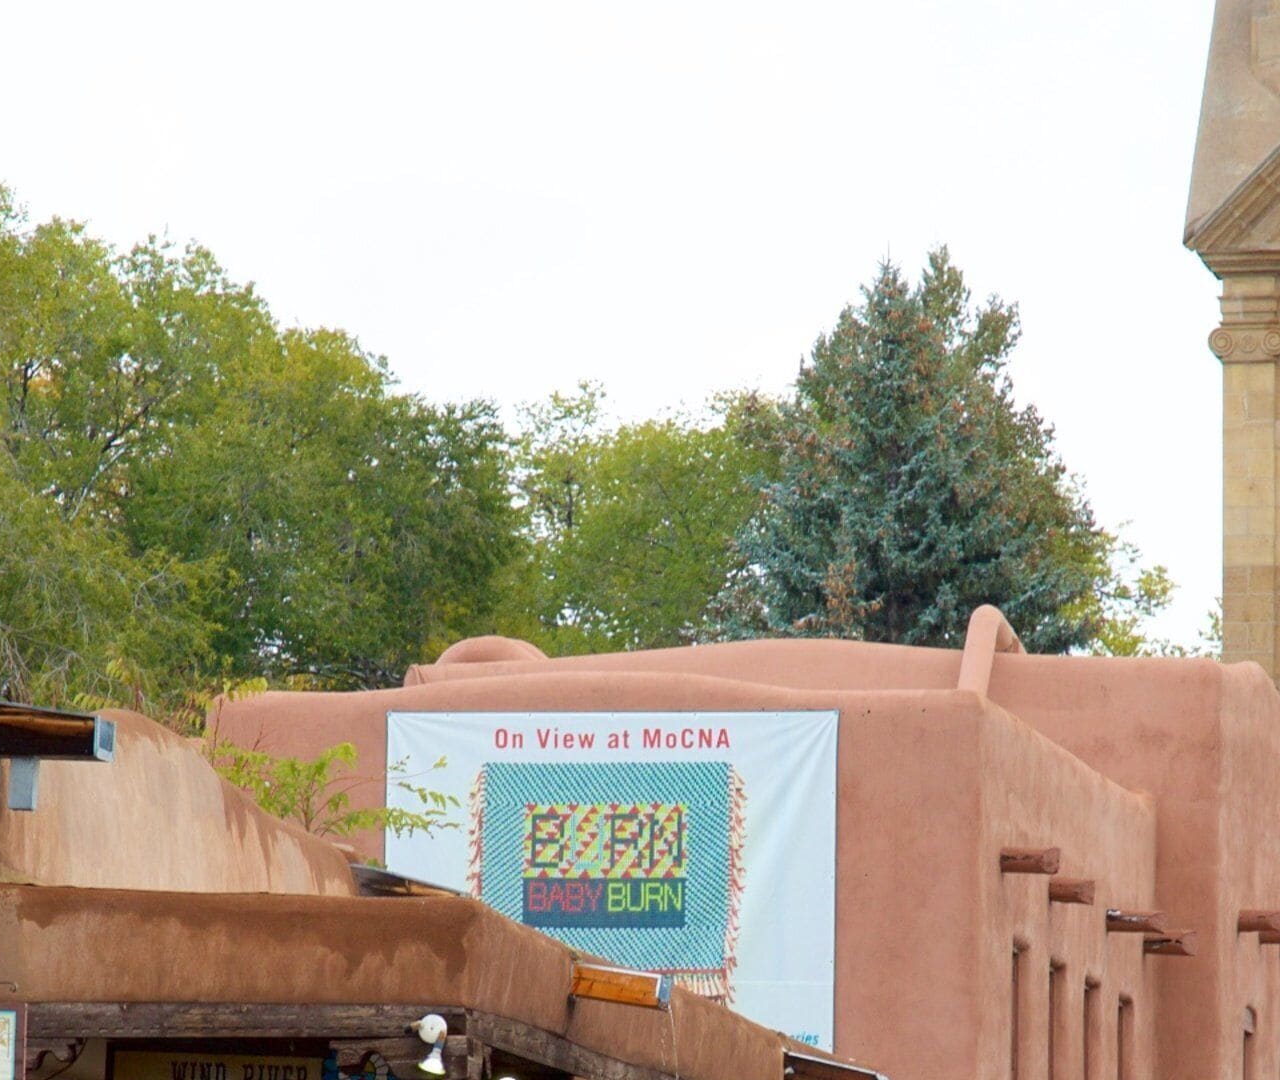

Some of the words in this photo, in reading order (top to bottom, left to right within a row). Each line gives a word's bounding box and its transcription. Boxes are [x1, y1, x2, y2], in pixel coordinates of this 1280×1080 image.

[494, 728, 524, 749] On
[537, 728, 595, 749] View
[608, 731, 630, 749] at
[642, 728, 731, 749] MoCNA
[528, 881, 603, 912] BABY
[607, 882, 683, 912] BURN
